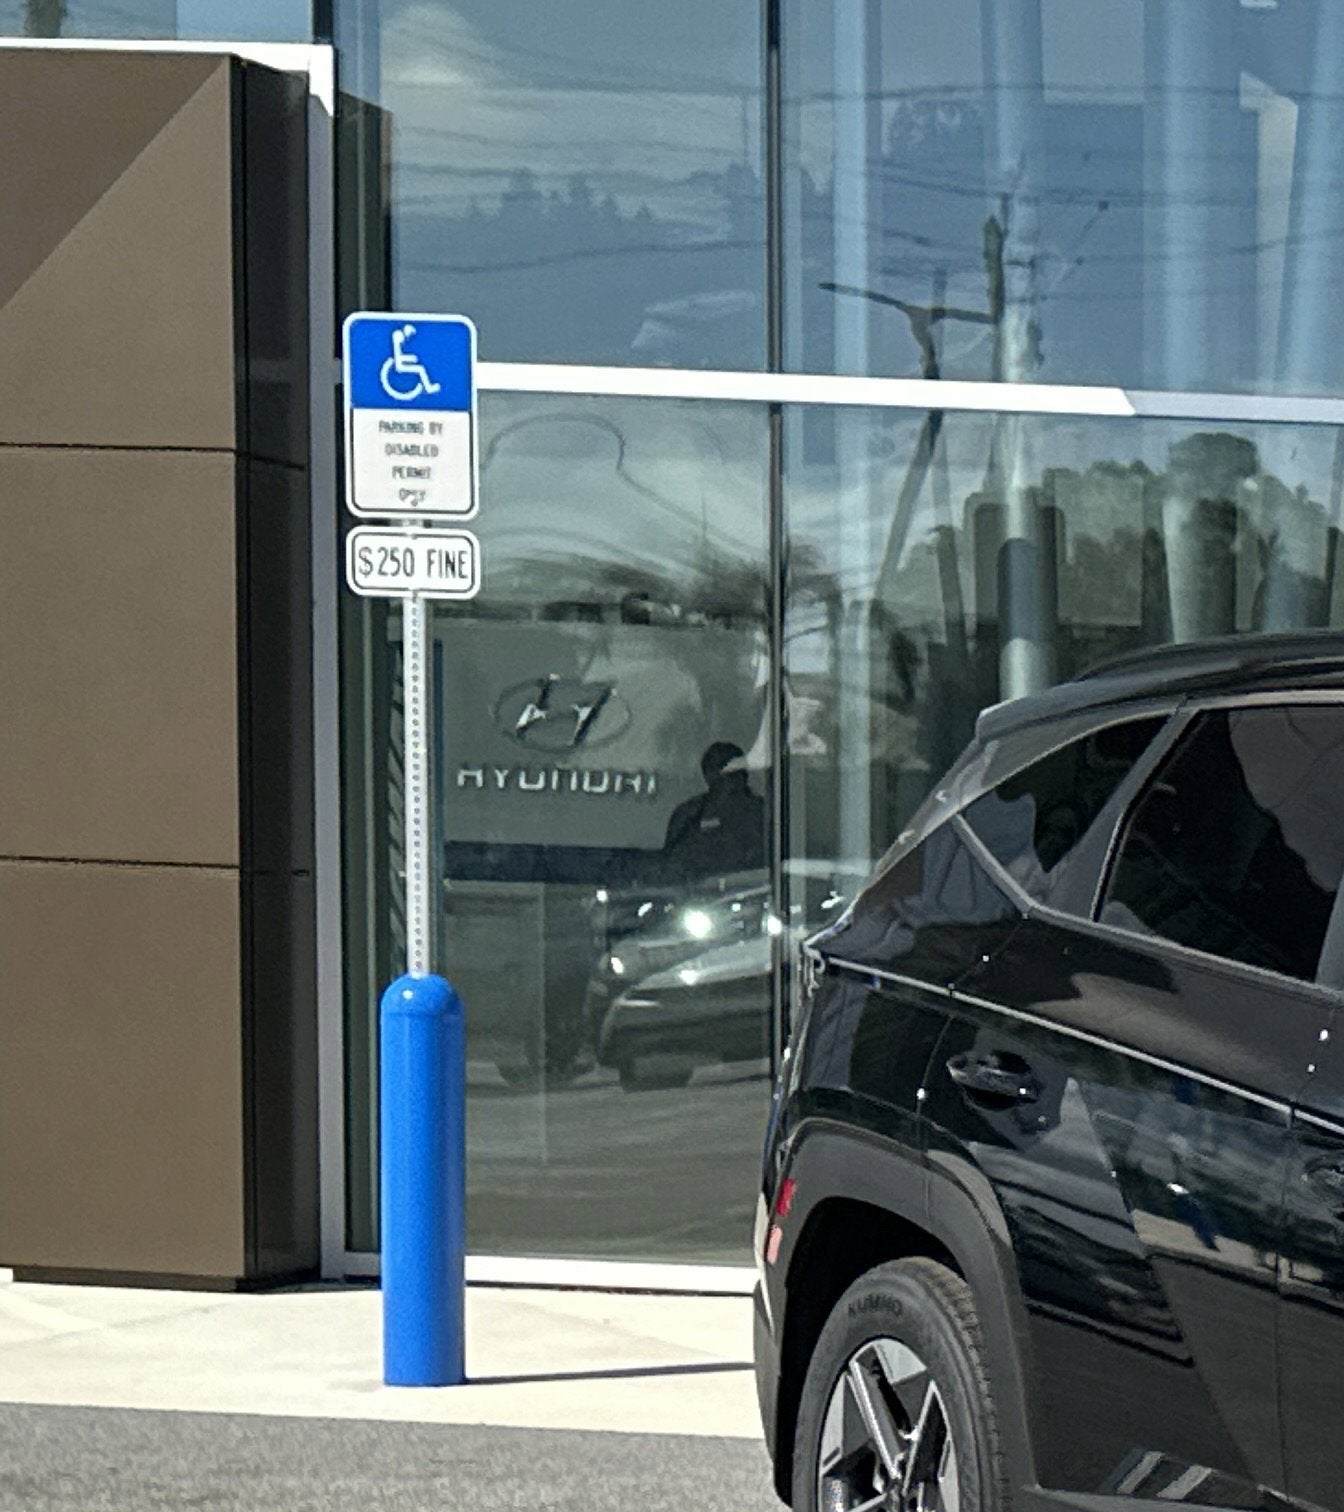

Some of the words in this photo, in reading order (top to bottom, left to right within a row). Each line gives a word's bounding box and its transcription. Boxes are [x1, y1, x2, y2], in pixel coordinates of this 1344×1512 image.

[378, 419, 424, 434] PARKING
[429, 421, 443, 435] BY
[384, 442, 439, 458] DISABLED
[391, 465, 432, 480] PERMIT
[357, 545, 416, 578] $250
[426, 549, 469, 580] FINE
[456, 765, 657, 795] HYUNDAI
